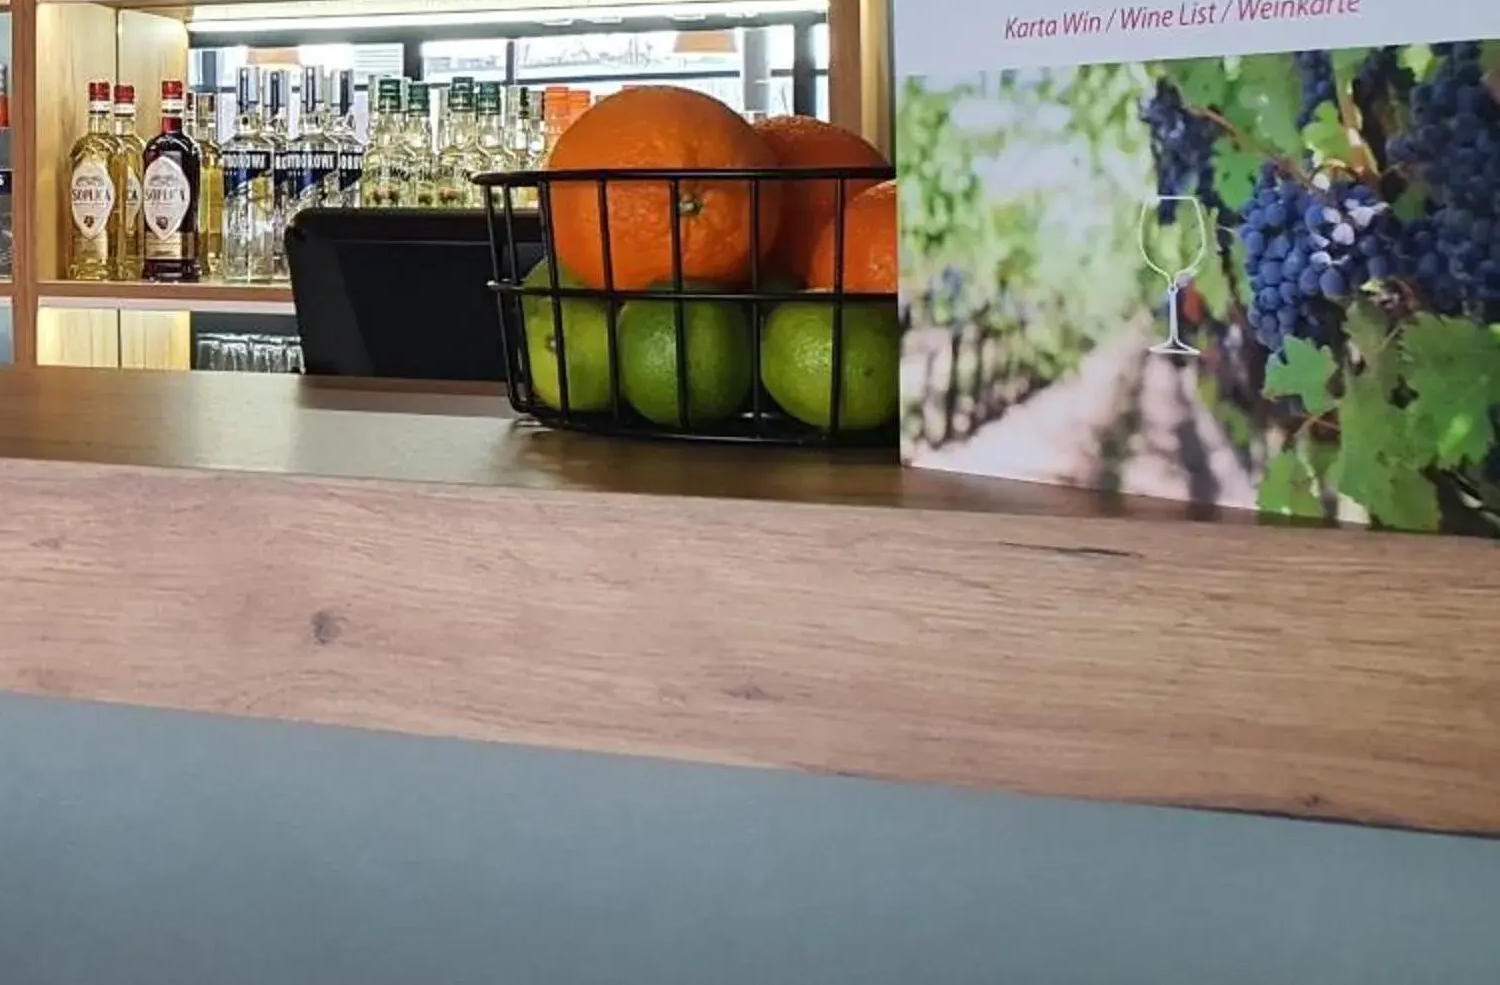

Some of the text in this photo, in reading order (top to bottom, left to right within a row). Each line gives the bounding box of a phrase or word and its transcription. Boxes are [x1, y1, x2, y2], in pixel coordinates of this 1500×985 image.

[1004, 16, 1058, 40] Karta
[1062, 12, 1101, 36] Win
[1120, 7, 1174, 32] Wine
[1178, 2, 1216, 27] List
